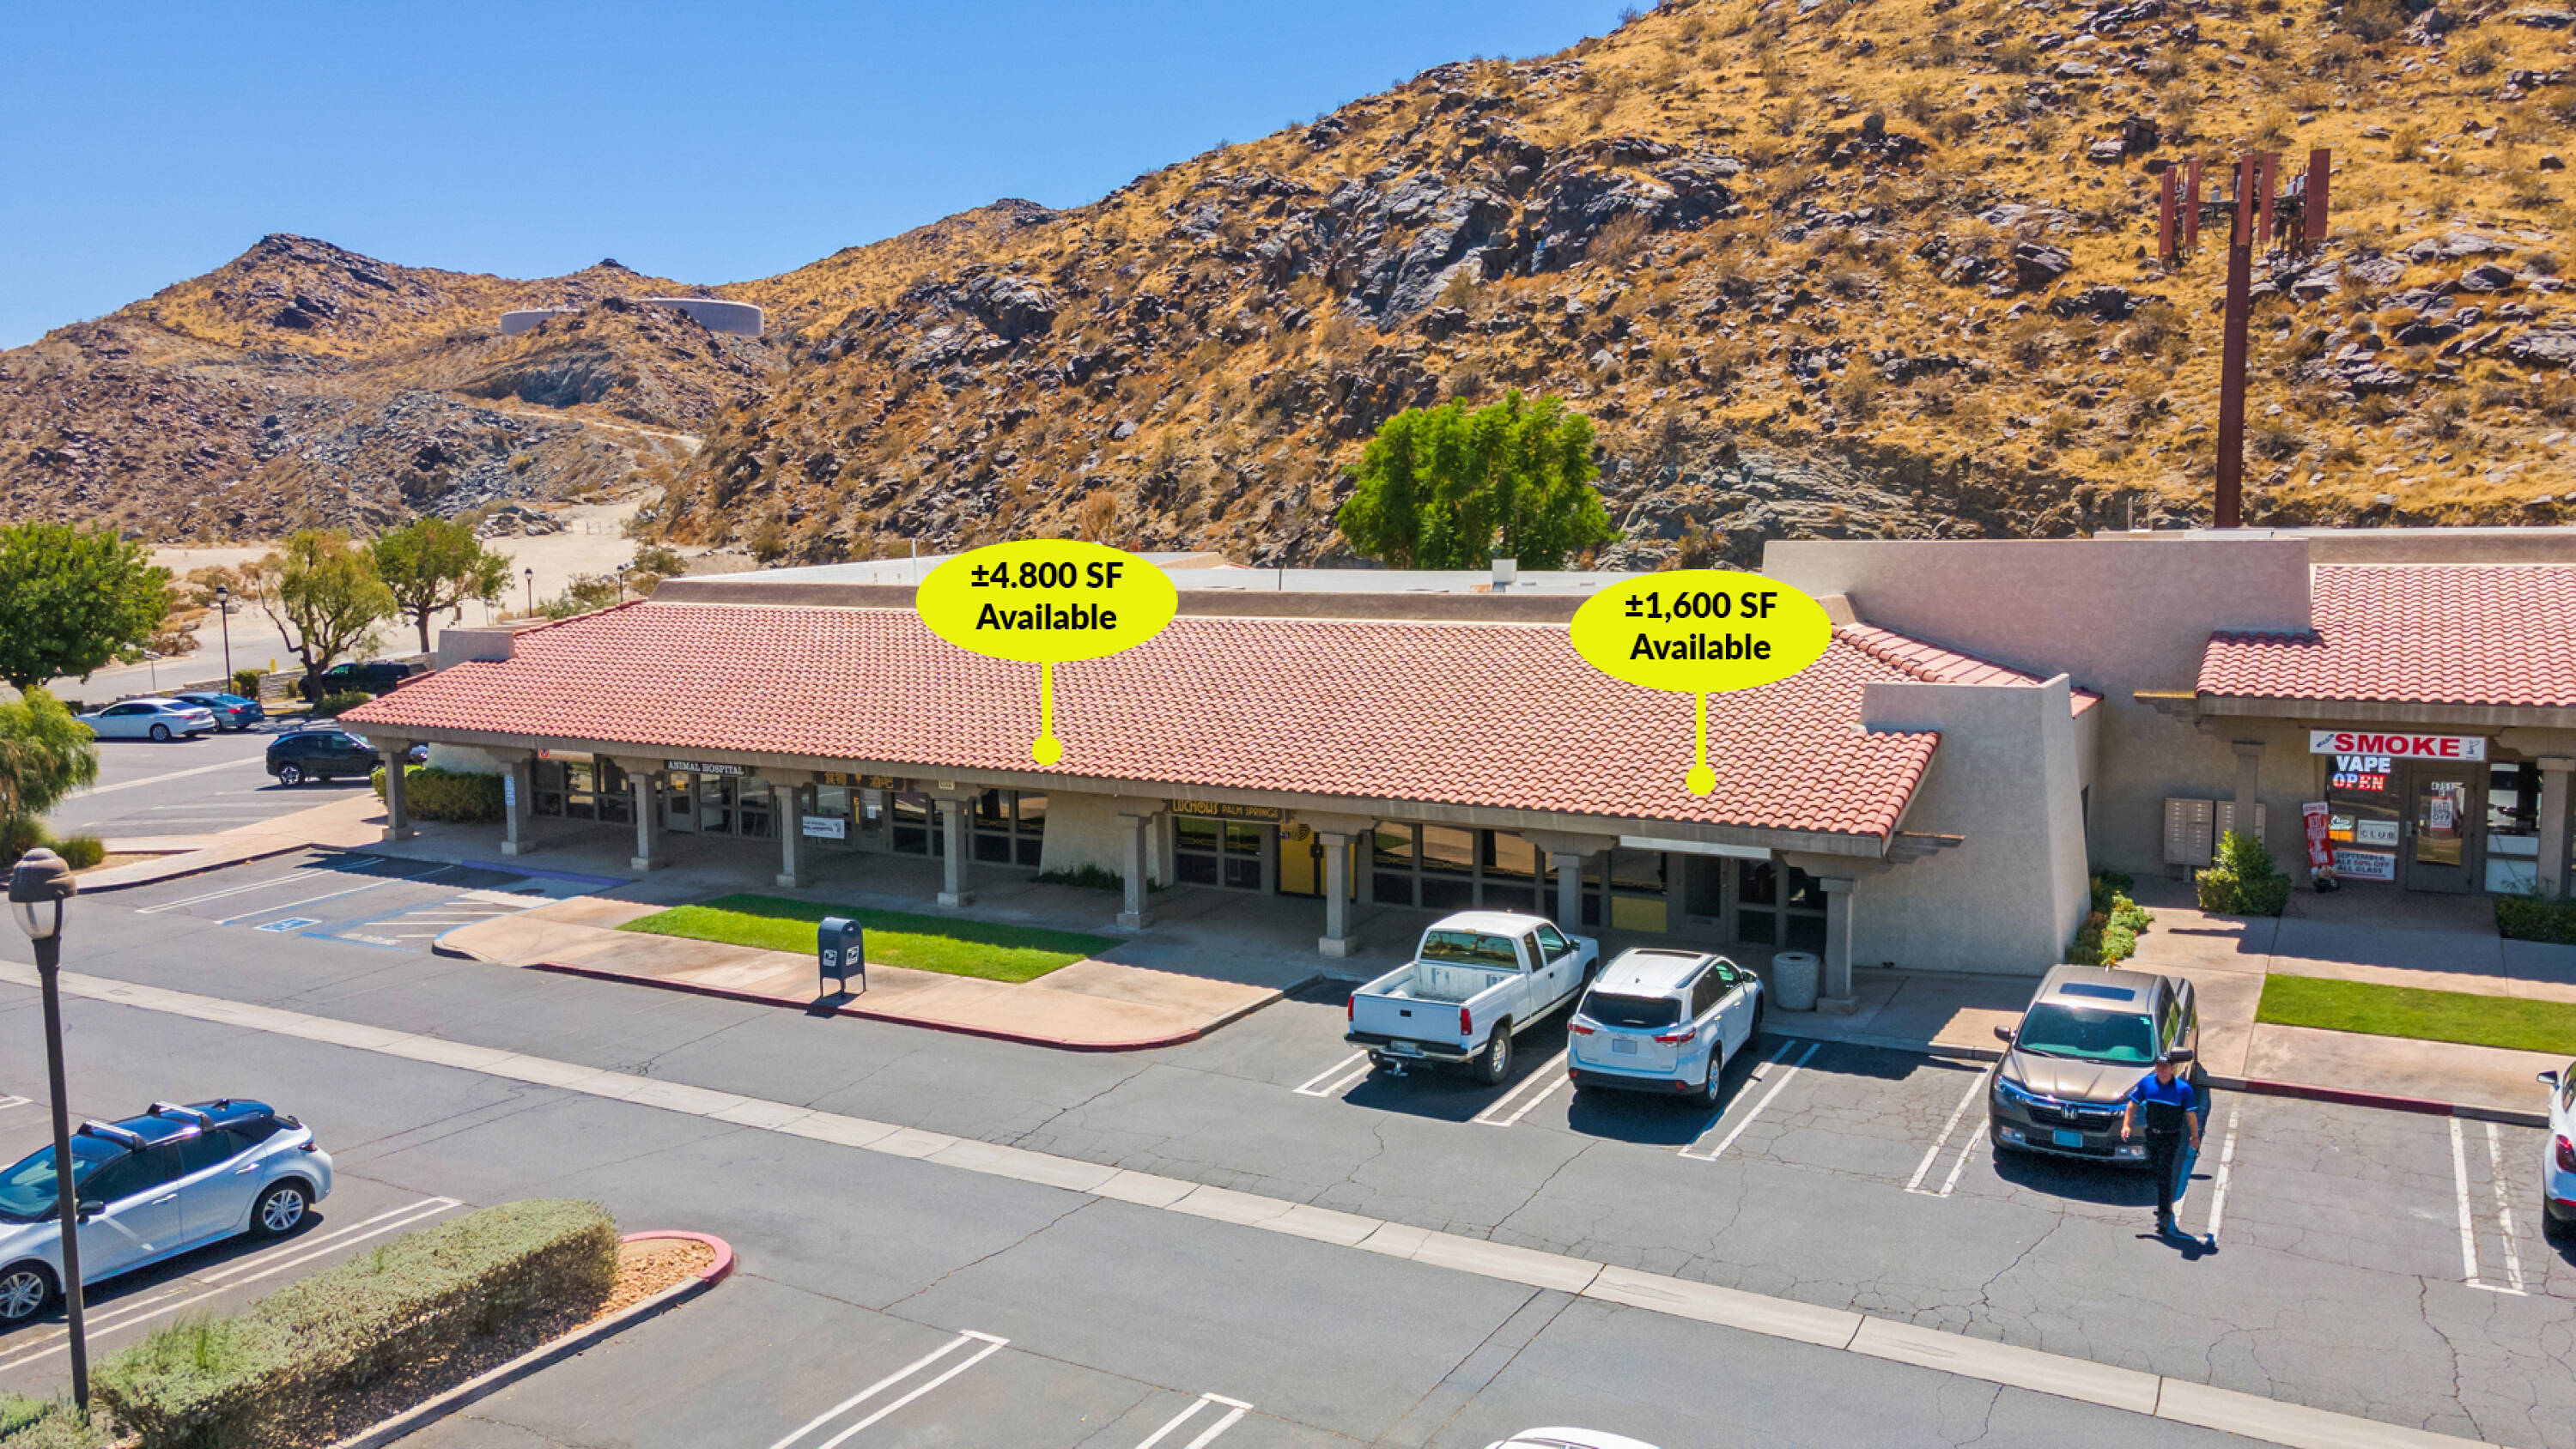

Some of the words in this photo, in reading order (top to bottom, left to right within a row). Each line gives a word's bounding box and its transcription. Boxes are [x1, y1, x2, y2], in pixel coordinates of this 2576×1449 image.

[2333, 733, 2461, 757] SMOKE
[667, 760, 700, 772] ANIMAL
[702, 763, 745, 775] HOSPITAL
[2335, 755, 2391, 773] VAPE
[2332, 772, 2385, 791] OPEN
[1222, 805, 1243, 816] PALM
[1245, 807, 1279, 819] SPRINGS
[2335, 852, 2385, 861] SEPTEMBER
